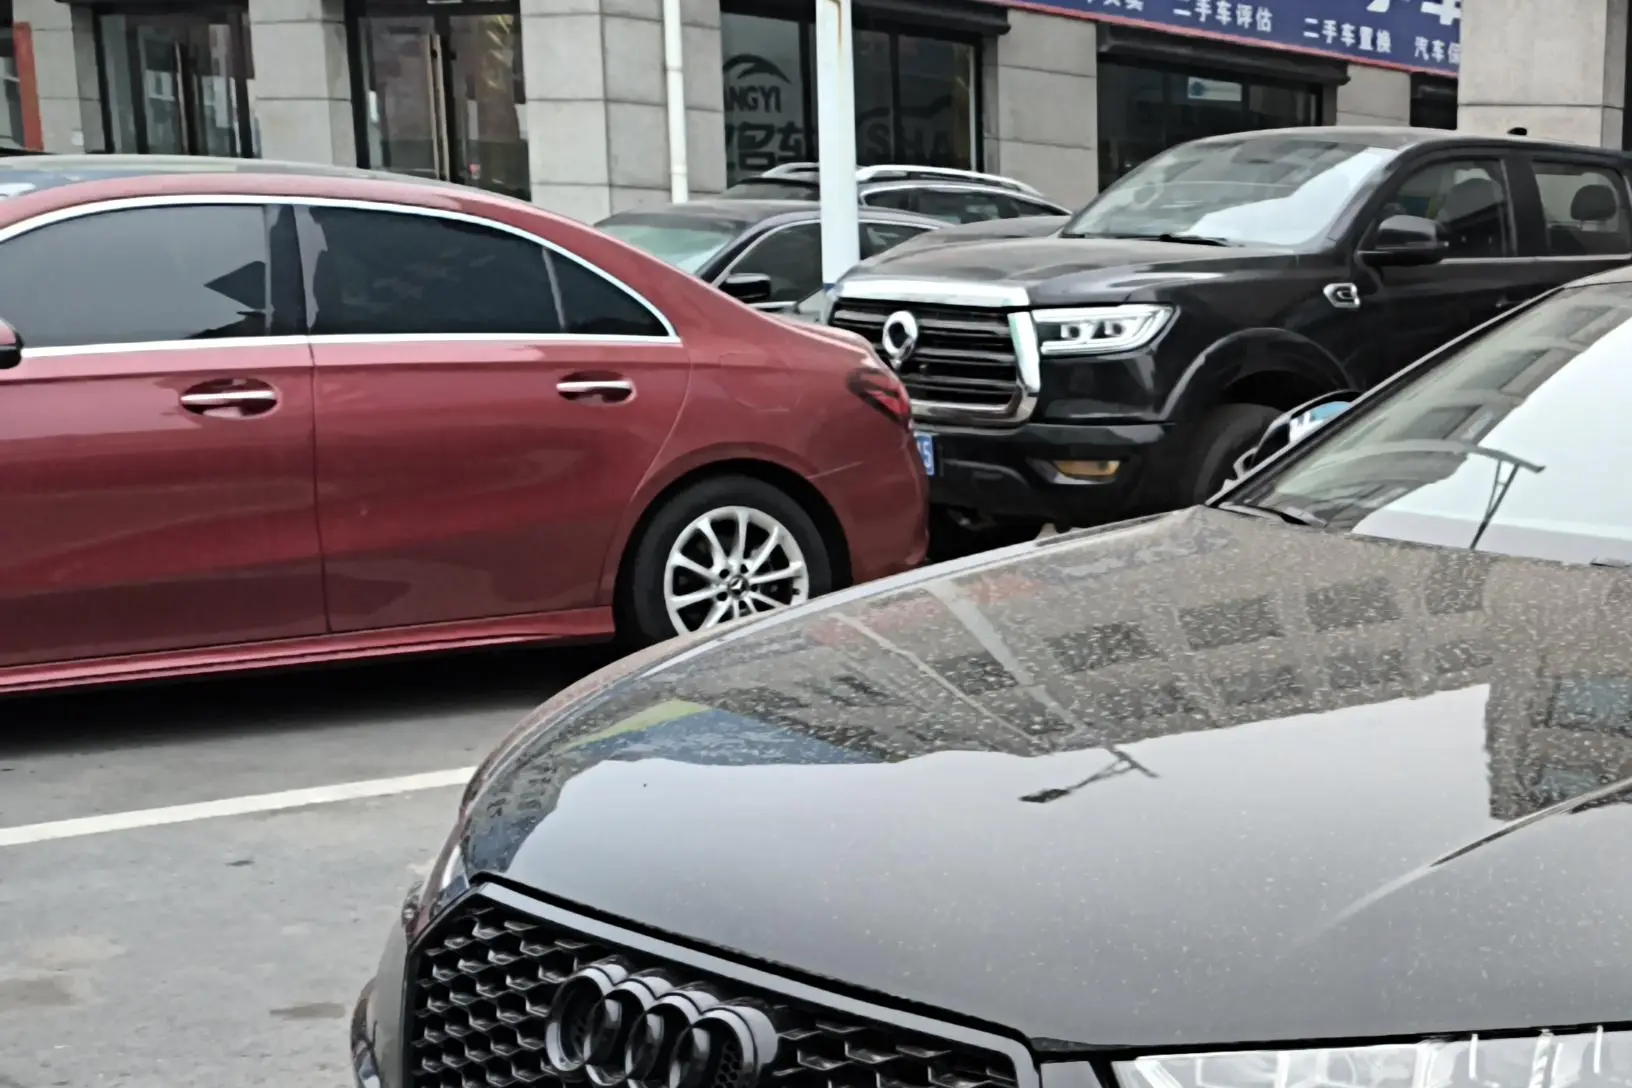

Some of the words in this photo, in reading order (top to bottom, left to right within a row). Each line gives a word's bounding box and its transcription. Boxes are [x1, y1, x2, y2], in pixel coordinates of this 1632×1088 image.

[1303, 17, 1392, 54] 二手车置换
